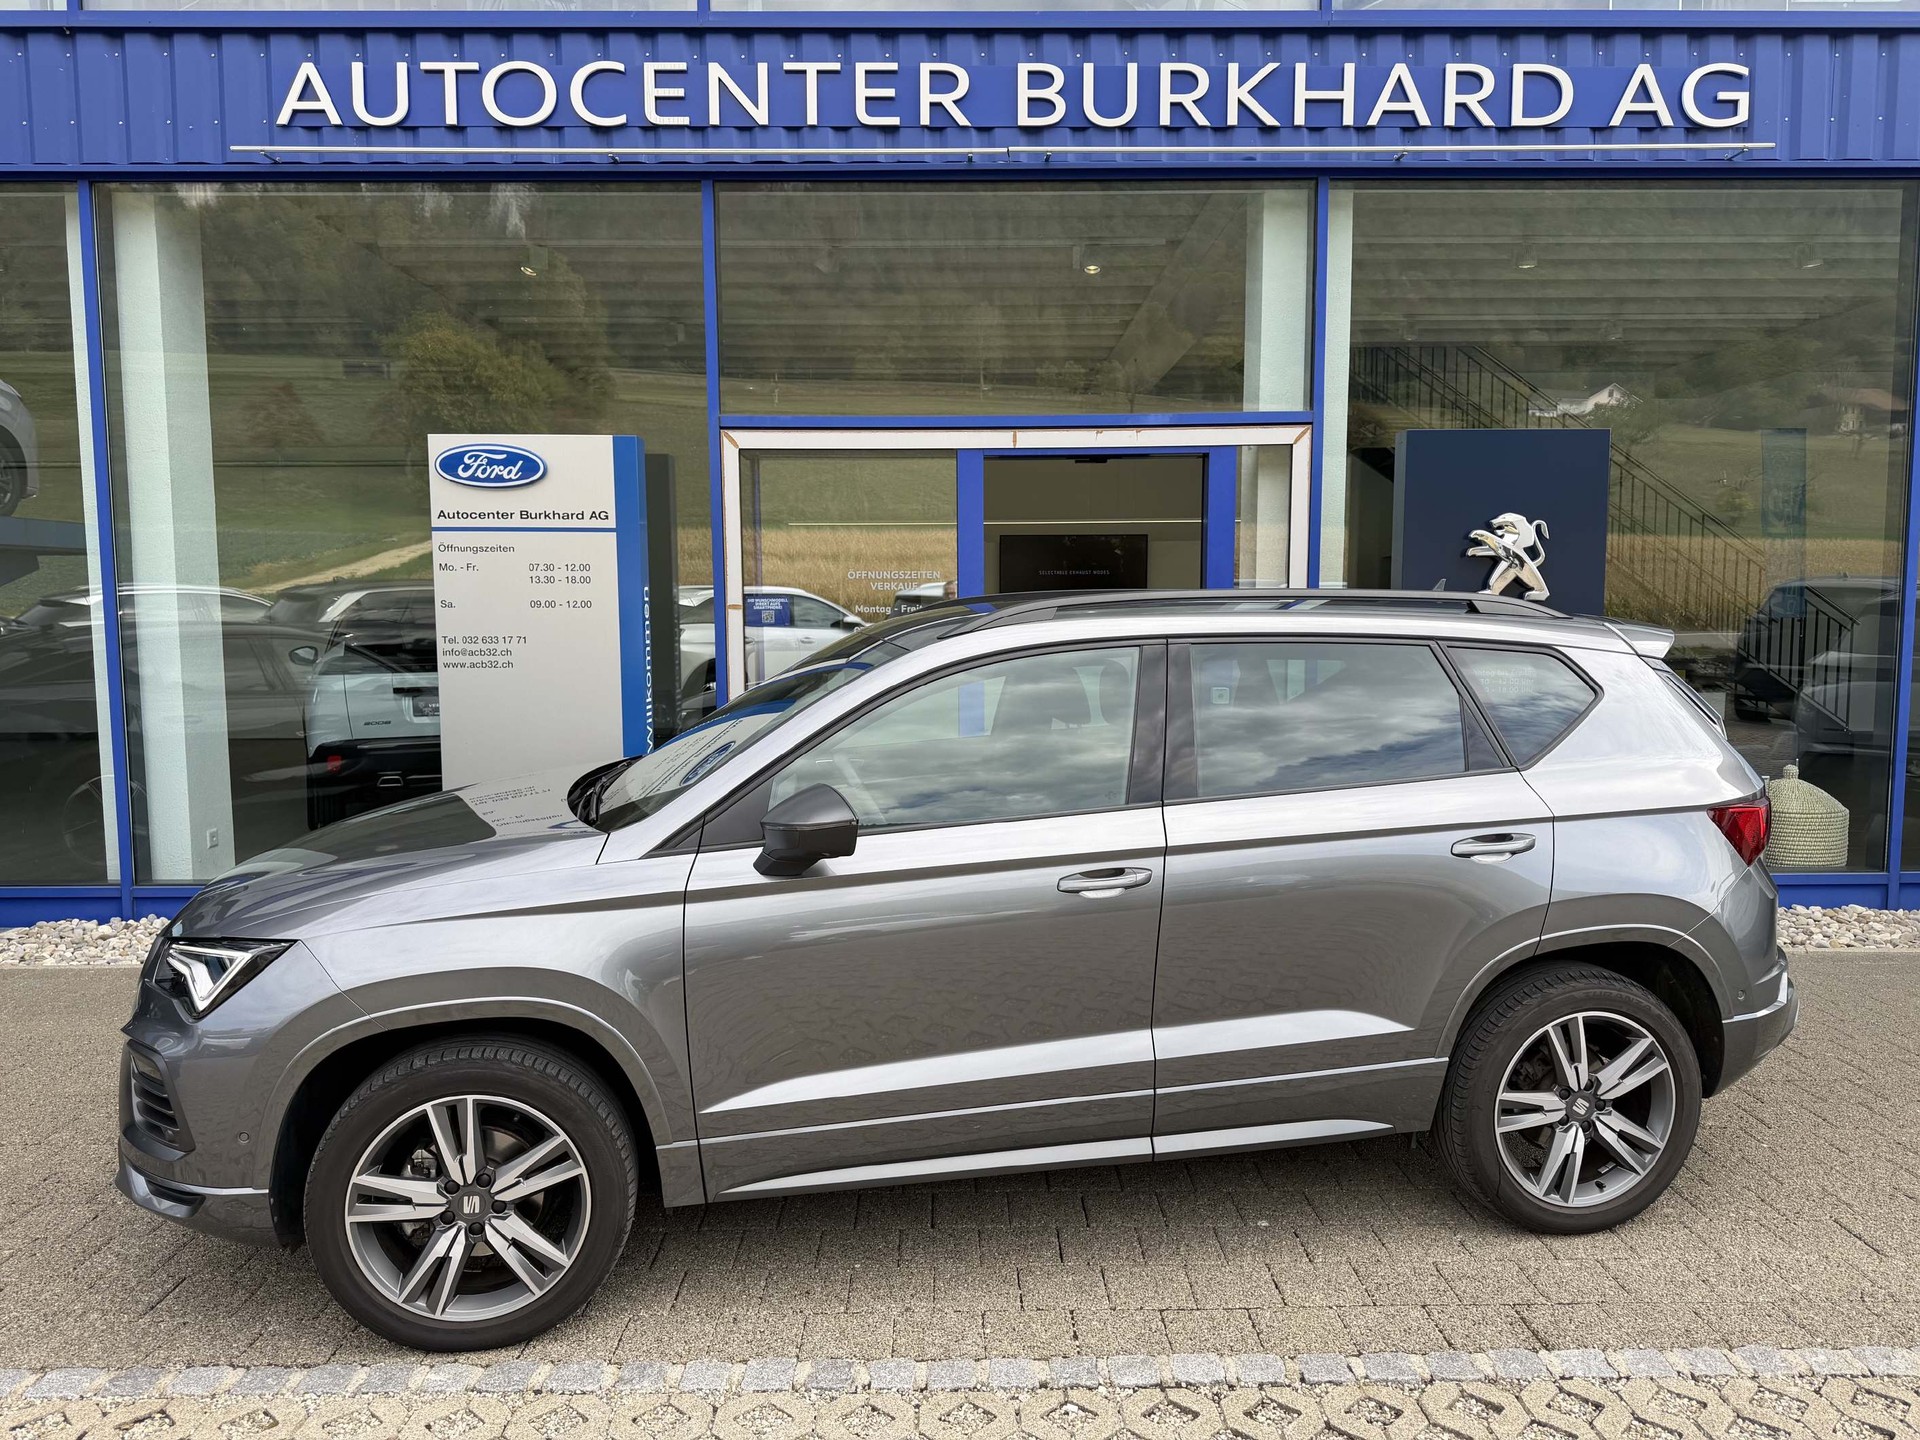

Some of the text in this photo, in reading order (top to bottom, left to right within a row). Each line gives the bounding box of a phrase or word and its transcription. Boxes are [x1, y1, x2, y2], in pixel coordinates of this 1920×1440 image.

[275, 60, 1750, 128] AUTOCENTER BURKHARD AG
[457, 451, 523, 481] Ford
[437, 510, 610, 521] Autocenter Burkhard AG
[438, 542, 515, 554] Öffnungszeiten
[439, 563, 457, 572] Mo.
[466, 563, 479, 572] Fr.
[529, 563, 555, 572] 07.30
[565, 563, 591, 572] 12.00
[847, 569, 940, 579] ÖFFNUNGSZEITEN
[529, 576, 555, 584] 13.30
[565, 576, 591, 584] 18.00
[870, 582, 918, 590] VERKAUF
[440, 600, 456, 609] Sa.
[530, 600, 556, 609] 09.00
[566, 600, 592, 609] 12.00
[855, 605, 892, 614] Montag
[442, 636, 527, 645] Tel. 032 633 17 71
[442, 648, 512, 657] info@acb32.ch
[443, 660, 514, 669] www.acb32.ch
[643, 586, 653, 754] Willkommen
